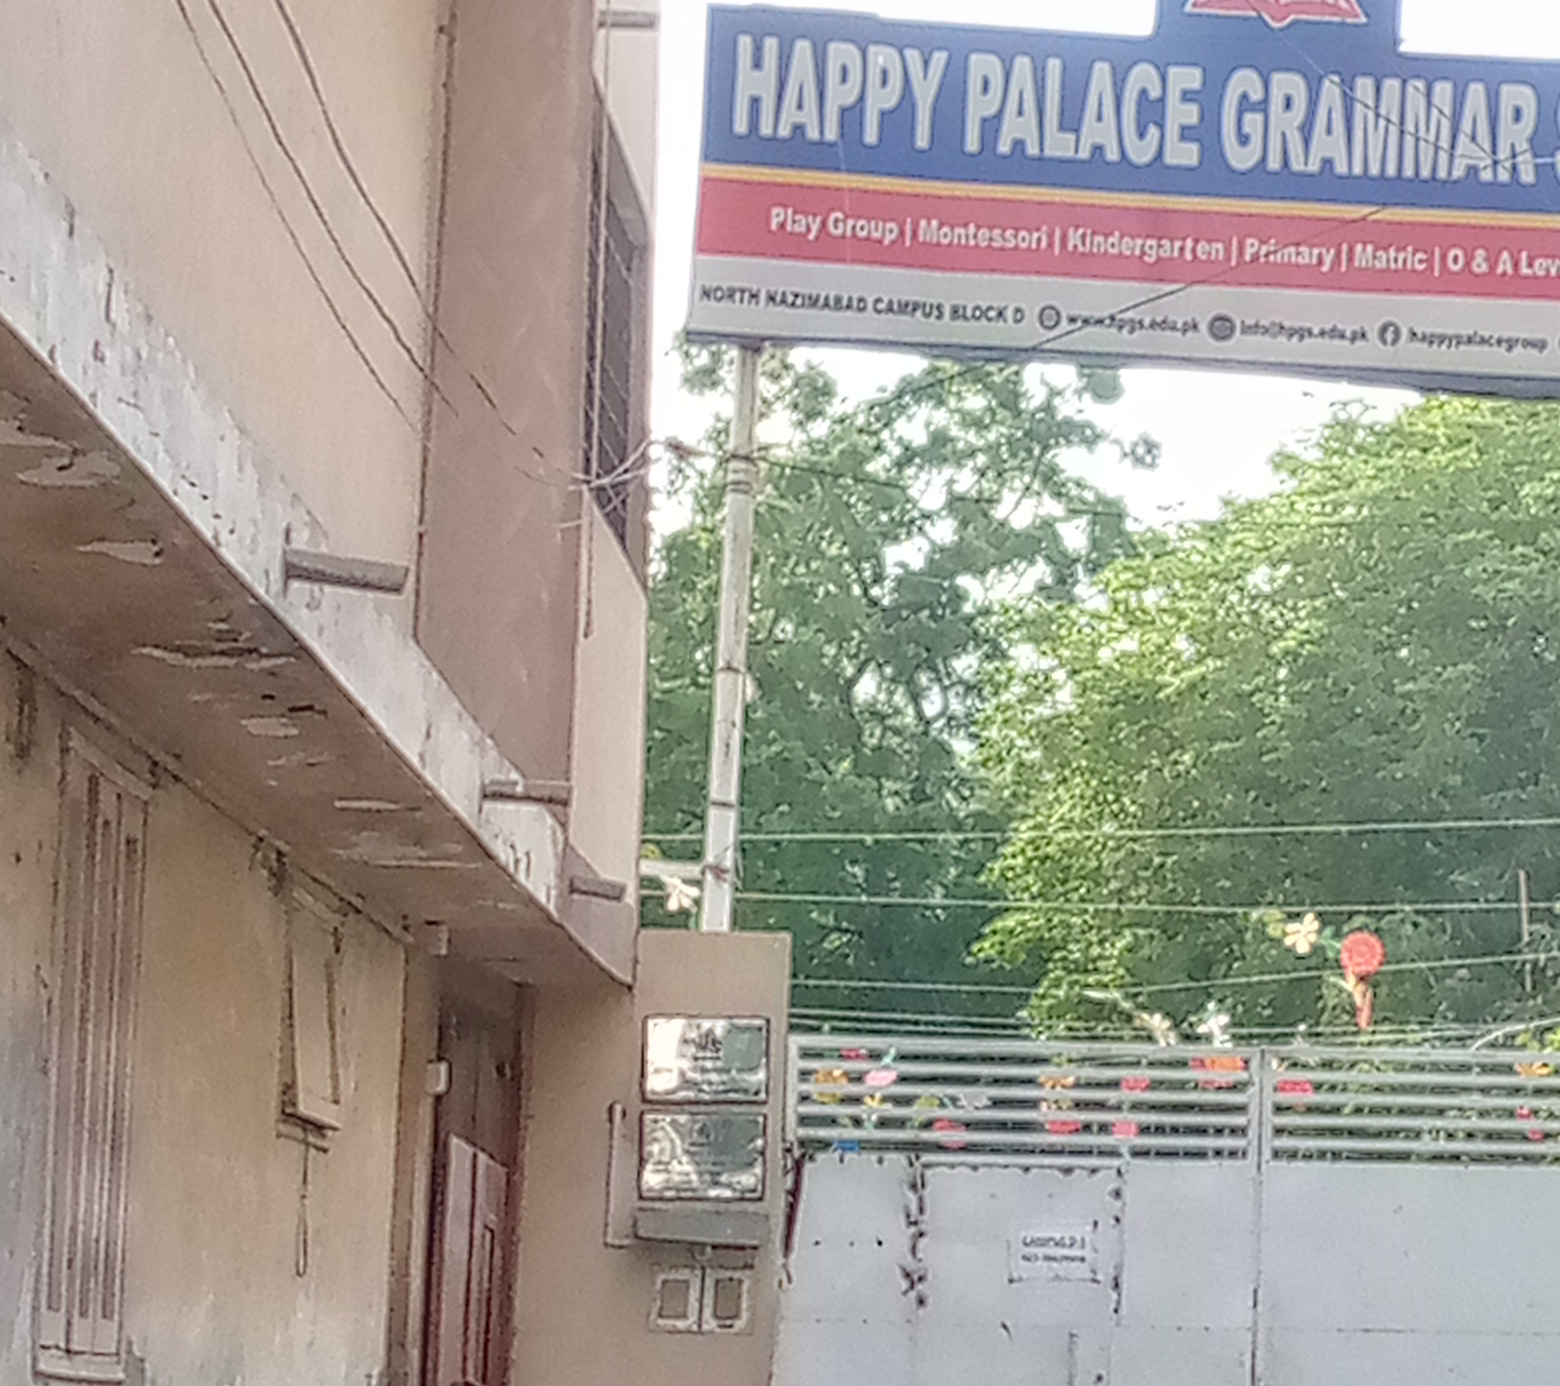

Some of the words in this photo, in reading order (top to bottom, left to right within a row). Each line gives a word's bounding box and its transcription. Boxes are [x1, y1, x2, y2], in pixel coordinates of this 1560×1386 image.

[730, 31, 950, 151] HAPPY
[963, 50, 1204, 169] PALACE
[1220, 66, 1538, 187] GRAMMAR
[769, 207, 822, 241] Play
[827, 211, 898, 246] Group
[917, 218, 1048, 251] Montessori
[1066, 226, 1225, 264] Kindergarten
[1243, 237, 1336, 273] Primary
[1353, 242, 1428, 271] Matric
[1446, 247, 1466, 272] O
[1470, 247, 1489, 275] &
[1495, 249, 1514, 276] A
[699, 284, 761, 307] NORTH
[764, 289, 867, 314] NAZIMABAD
[872, 297, 945, 321] CAMPUS
[948, 303, 1009, 324] BLOCK
[1012, 306, 1026, 325] D
